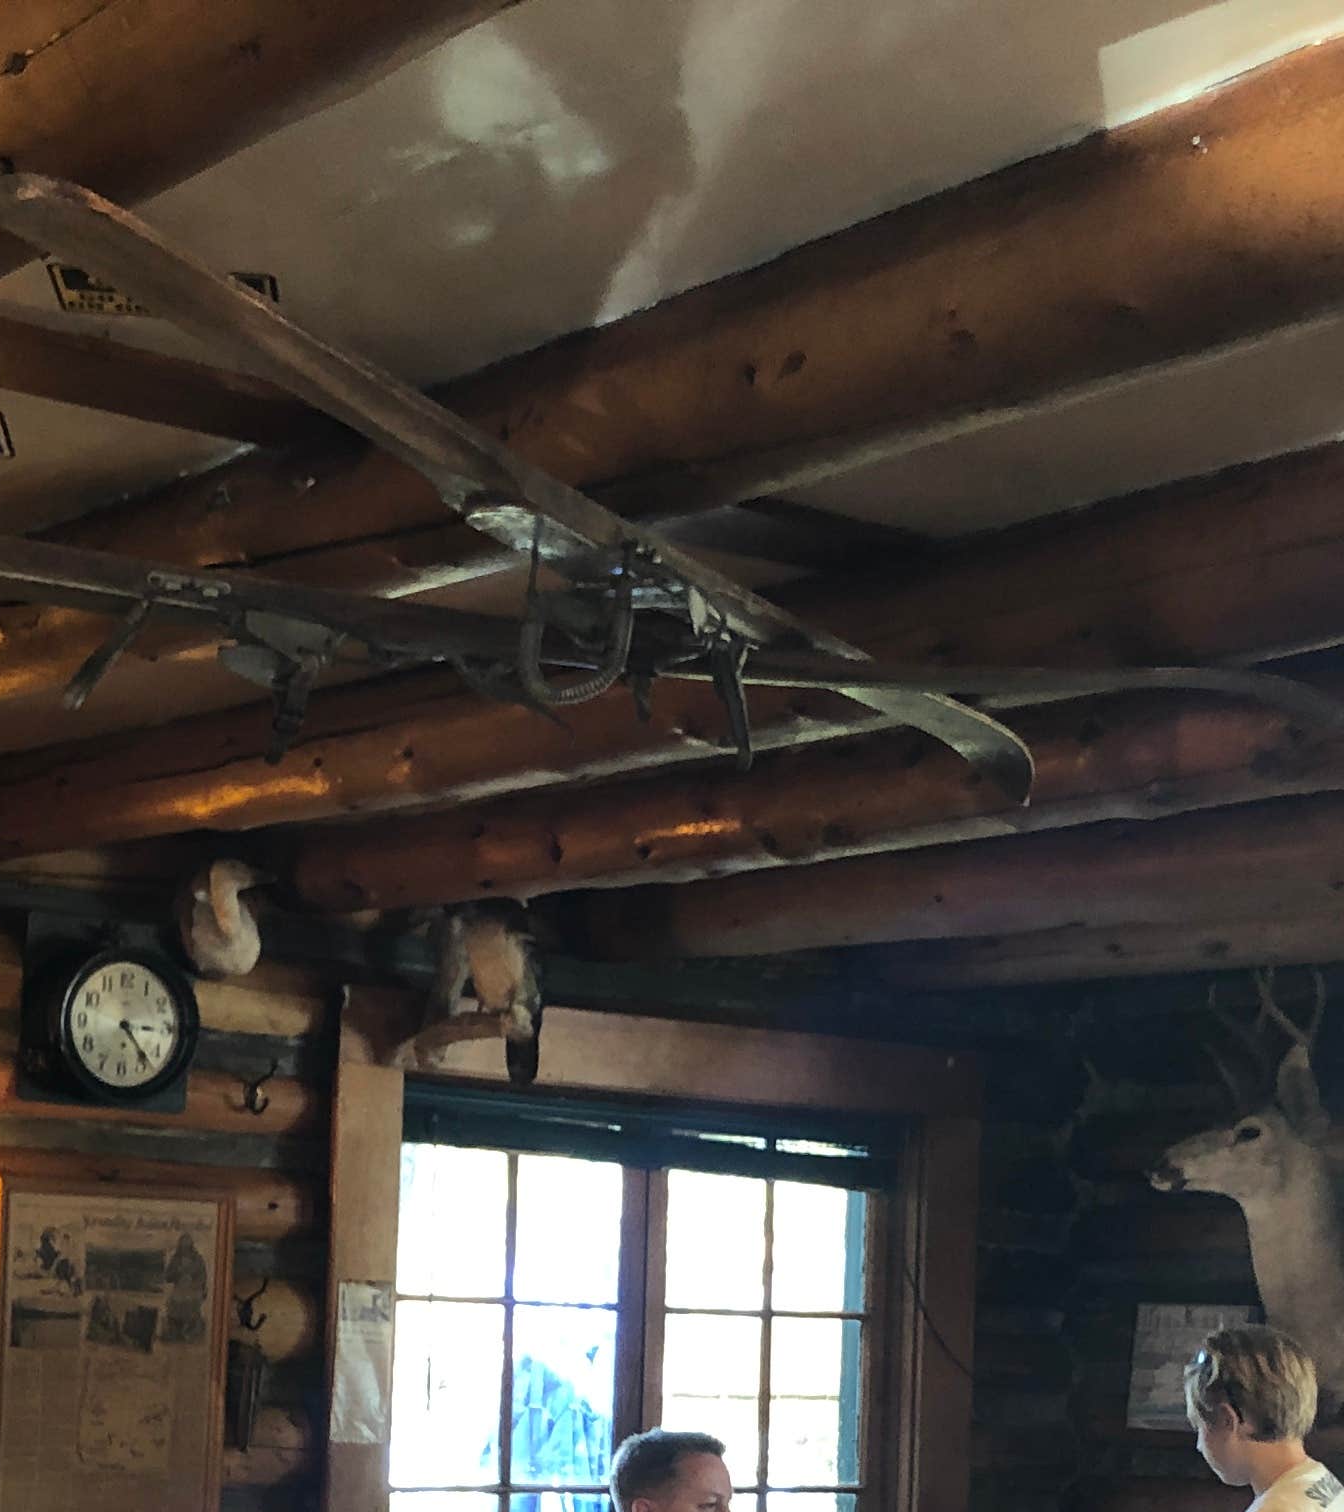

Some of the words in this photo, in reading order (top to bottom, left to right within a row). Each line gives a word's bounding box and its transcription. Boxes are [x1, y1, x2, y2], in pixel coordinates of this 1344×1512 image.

[102, 976, 113, 992] 11
[120, 972, 135, 989] 12
[143, 980, 150, 997] 1
[85, 992, 100, 1008] 10
[156, 997, 167, 1013] 2
[77, 1012, 87, 1028] 9
[82, 1036, 94, 1052] 8
[97, 1053, 108, 1071] 7
[116, 1060, 126, 1076] 6
